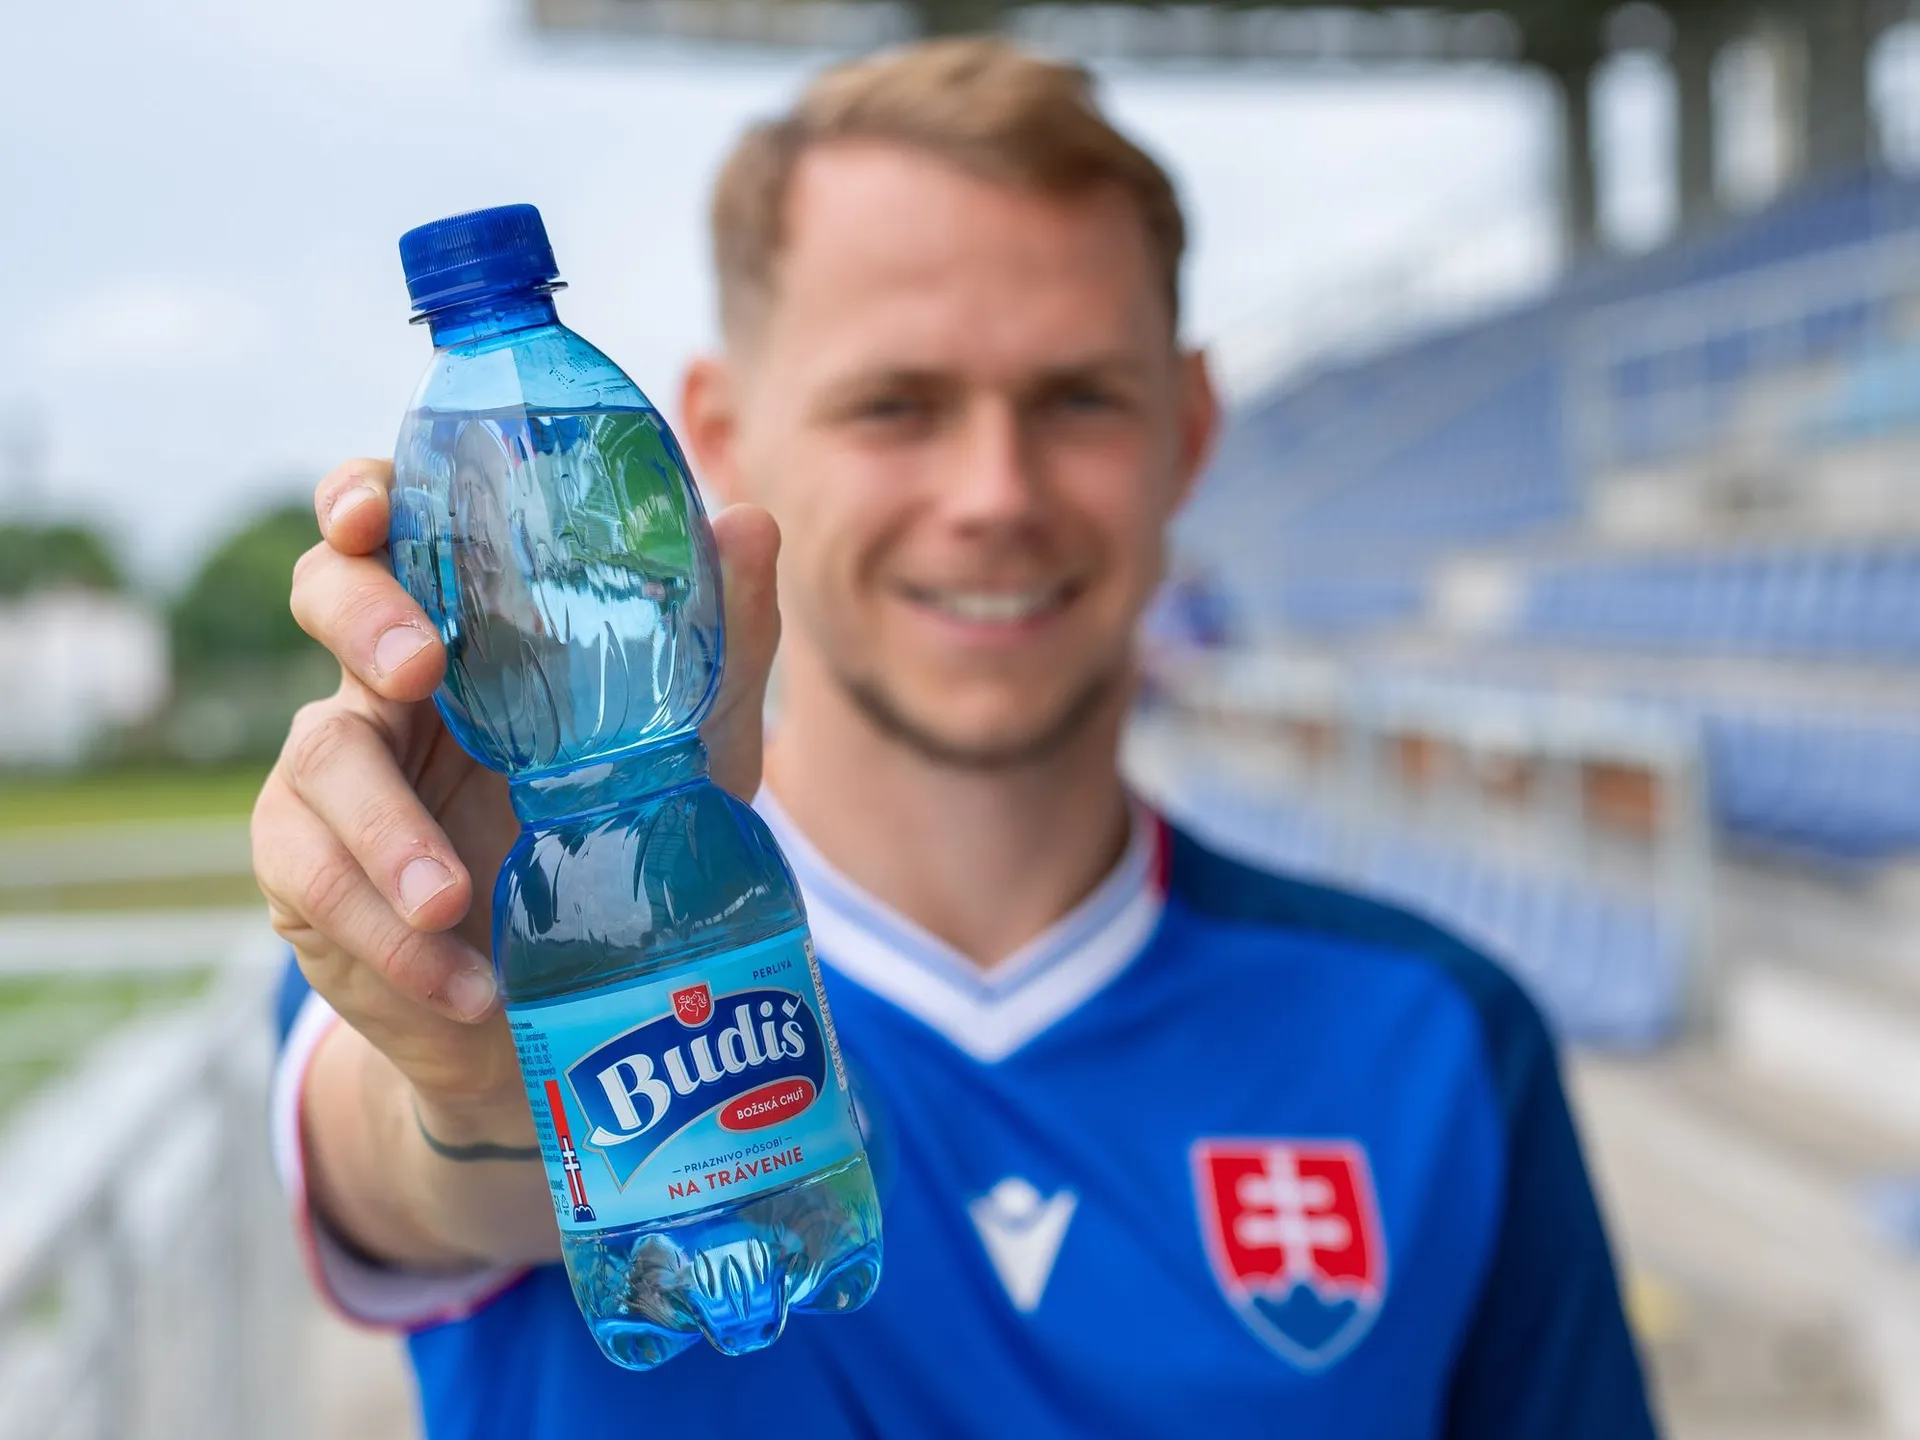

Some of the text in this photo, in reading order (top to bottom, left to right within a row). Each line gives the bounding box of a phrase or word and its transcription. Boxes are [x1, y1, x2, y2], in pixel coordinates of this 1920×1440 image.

[752, 959, 793, 981] PERLIVÁ
[590, 993, 805, 1147] Budiš
[736, 1087, 805, 1120] BOŽSKÁ CHUŤ
[668, 1146, 804, 1200] NA TRÁVENIE
[684, 1136, 784, 1174] PRIAZNIVO PÔSOBÍ
